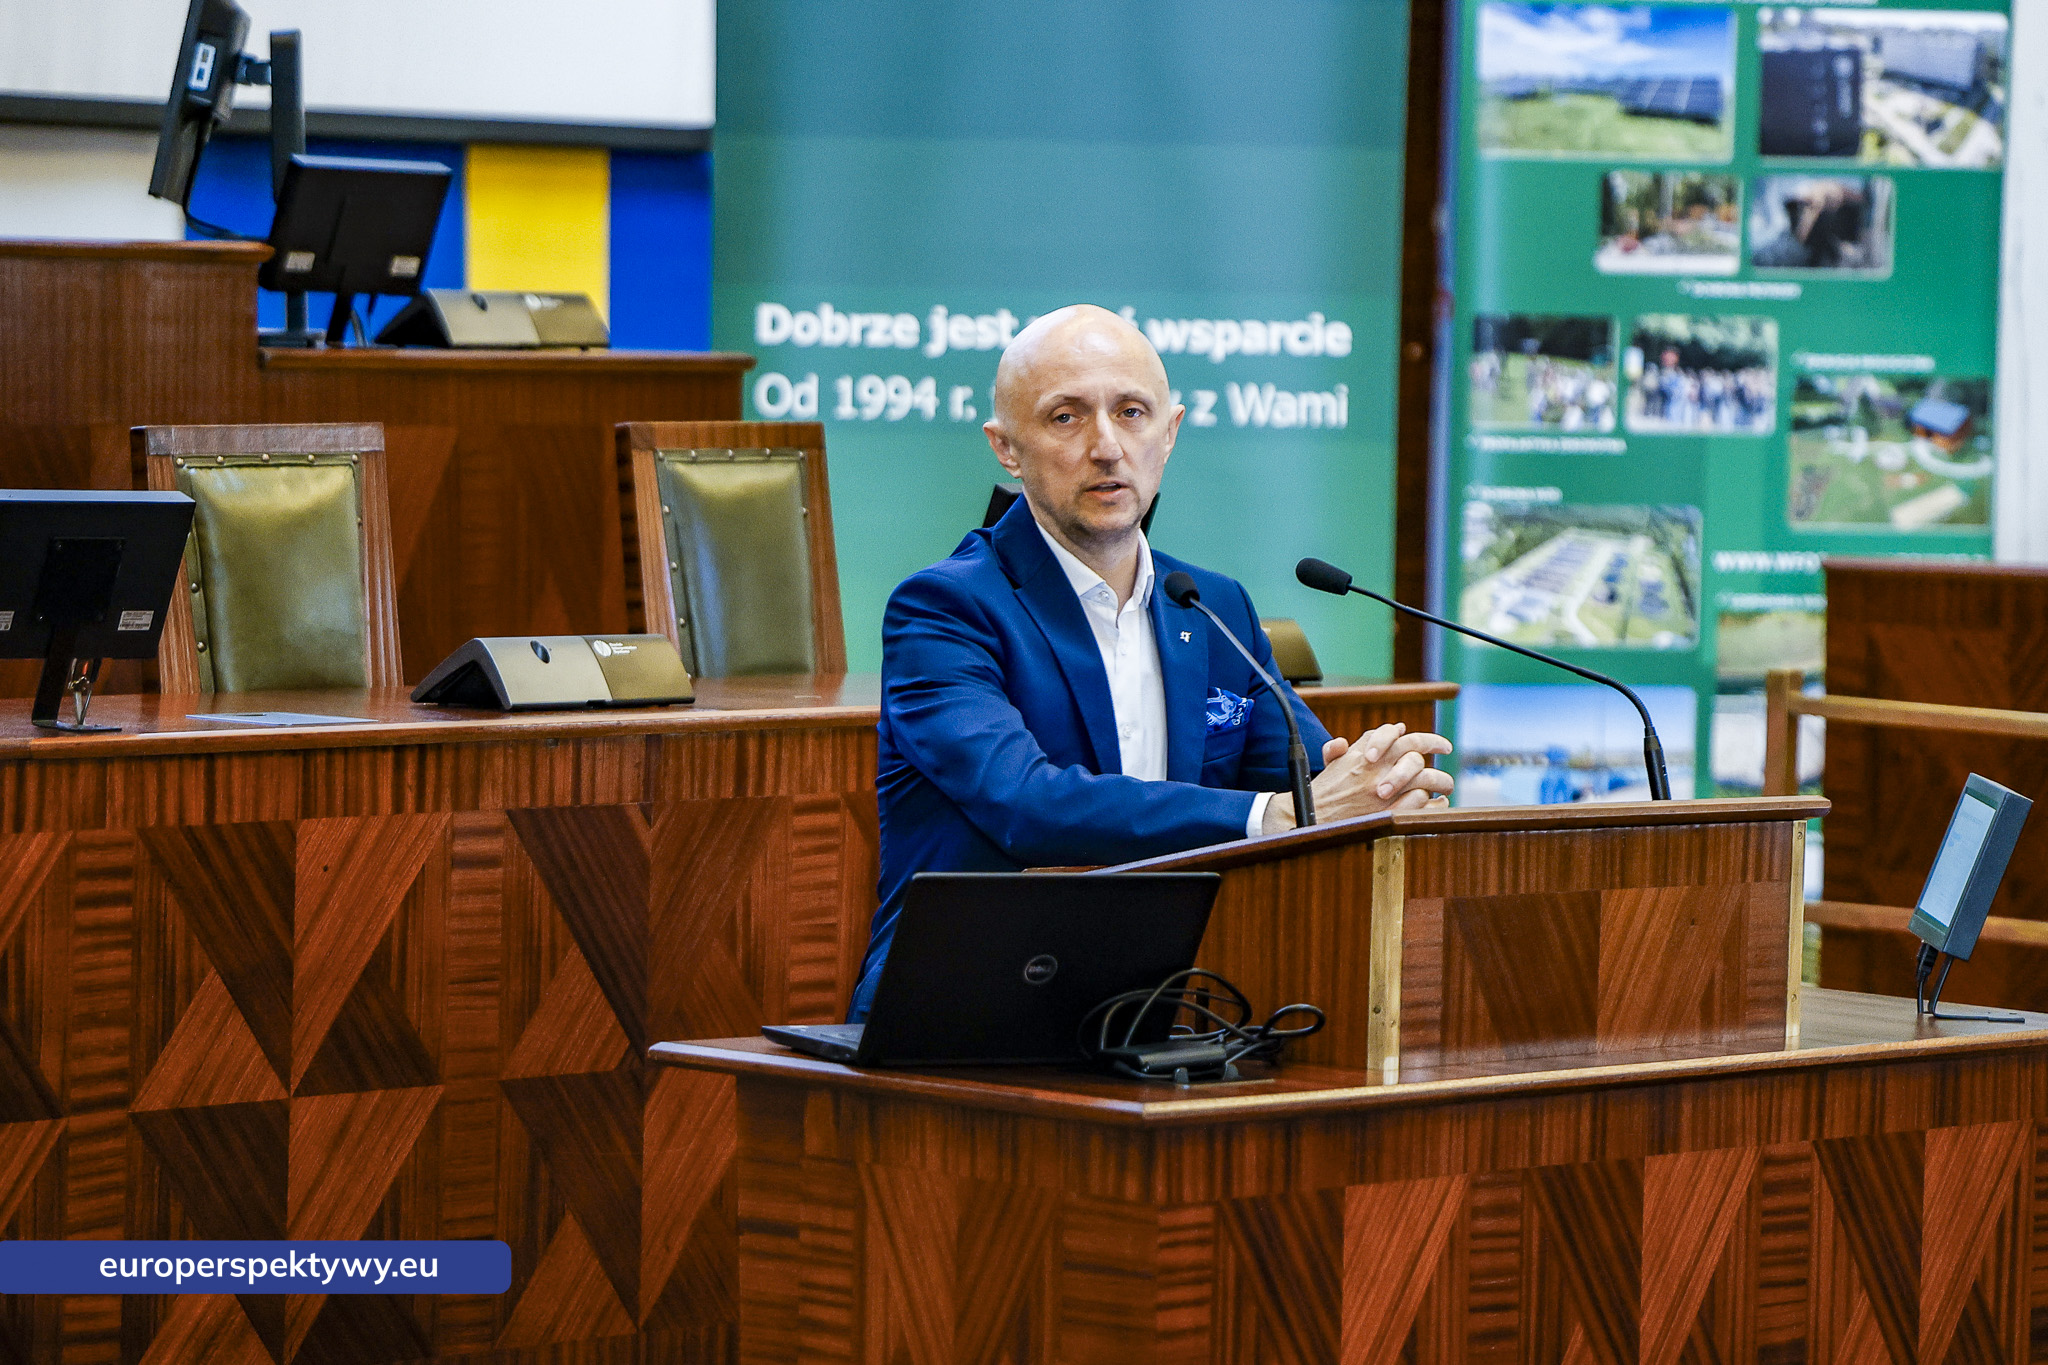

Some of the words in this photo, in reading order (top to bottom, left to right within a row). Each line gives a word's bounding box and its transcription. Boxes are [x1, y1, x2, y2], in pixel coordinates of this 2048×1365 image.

[755, 302, 920, 350] Dobrze
[925, 304, 1019, 358] jest
[1146, 311, 1353, 363] wsparcie
[754, 372, 818, 420] Od
[835, 374, 939, 421] 1994
[949, 385, 978, 422] r.
[1189, 389, 1218, 427] z
[1225, 382, 1349, 430] Wami
